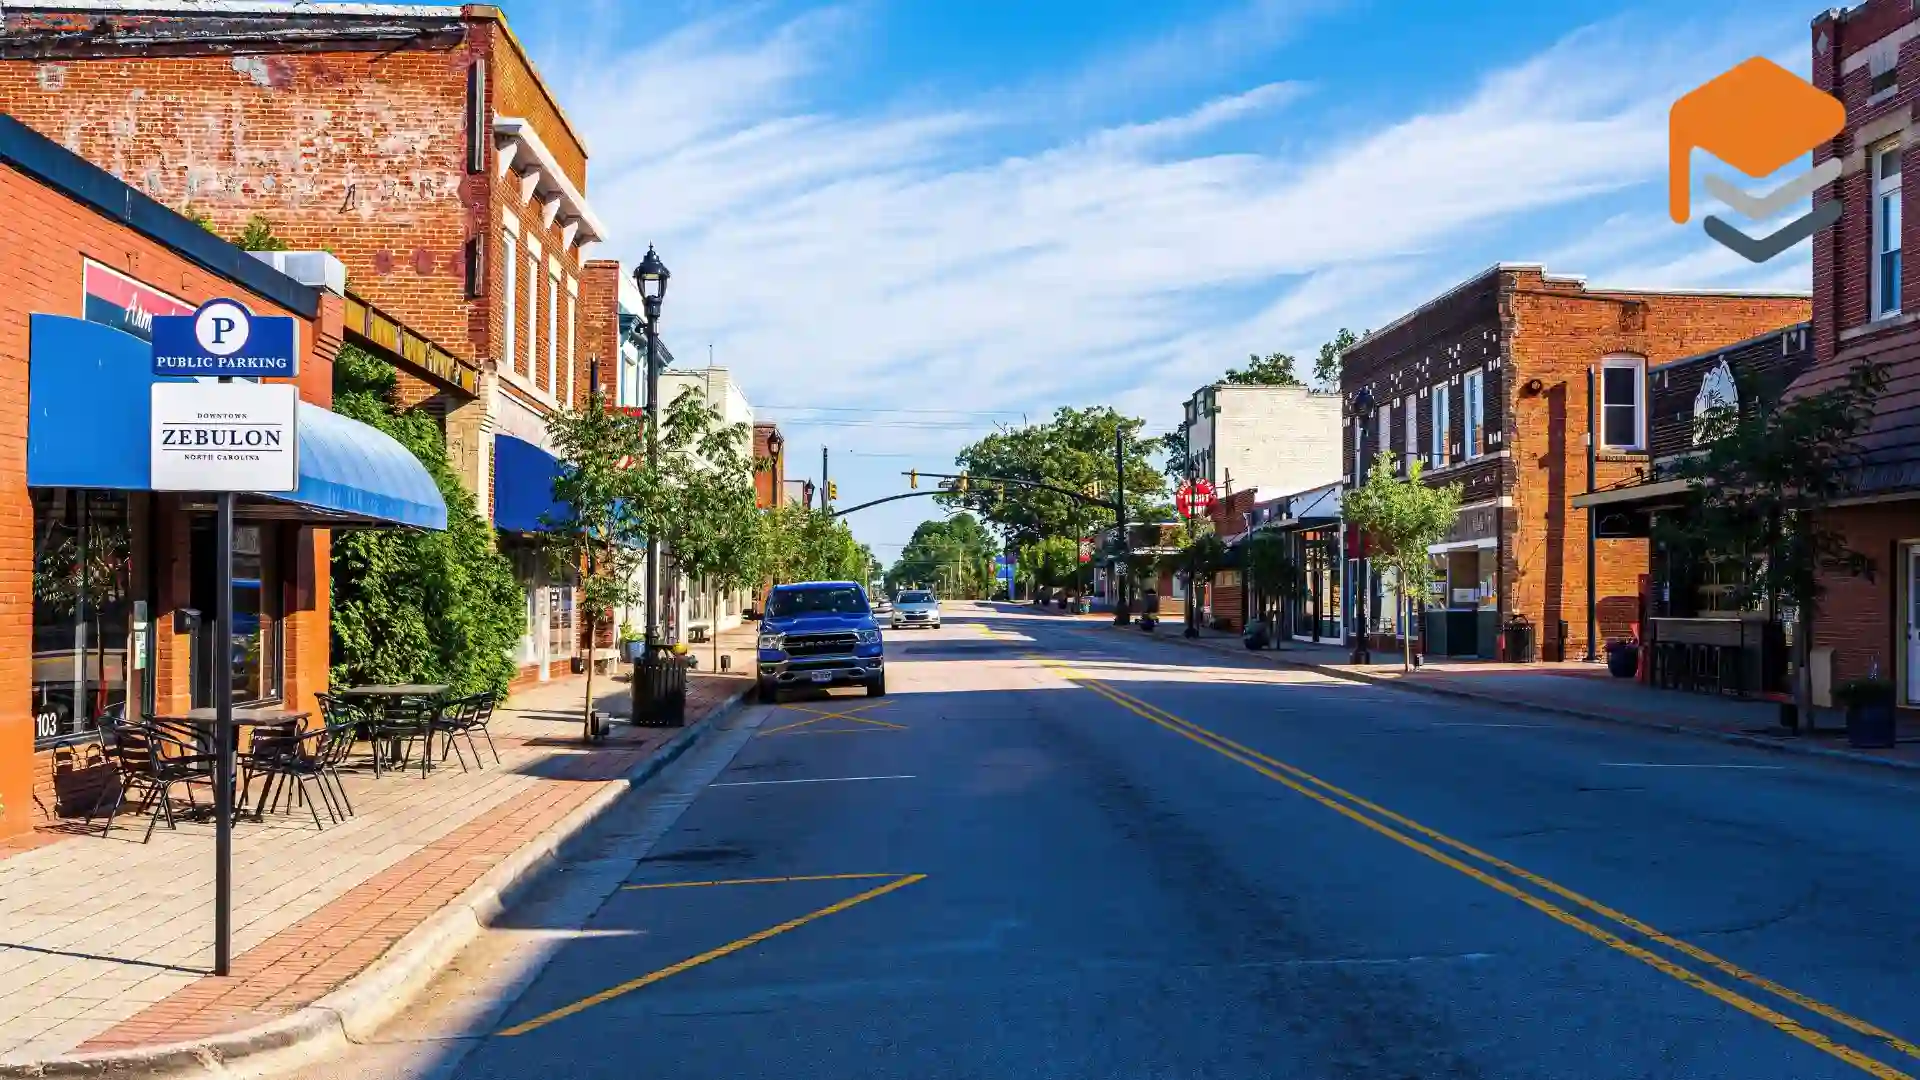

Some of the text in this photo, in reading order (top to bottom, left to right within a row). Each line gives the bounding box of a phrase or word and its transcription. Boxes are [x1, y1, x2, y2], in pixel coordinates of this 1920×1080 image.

[211, 317, 235, 344] P
[156, 356, 287, 369] PUBLIC PARKING
[162, 429, 281, 446] ZEBULON
[36, 712, 57, 737] 103
